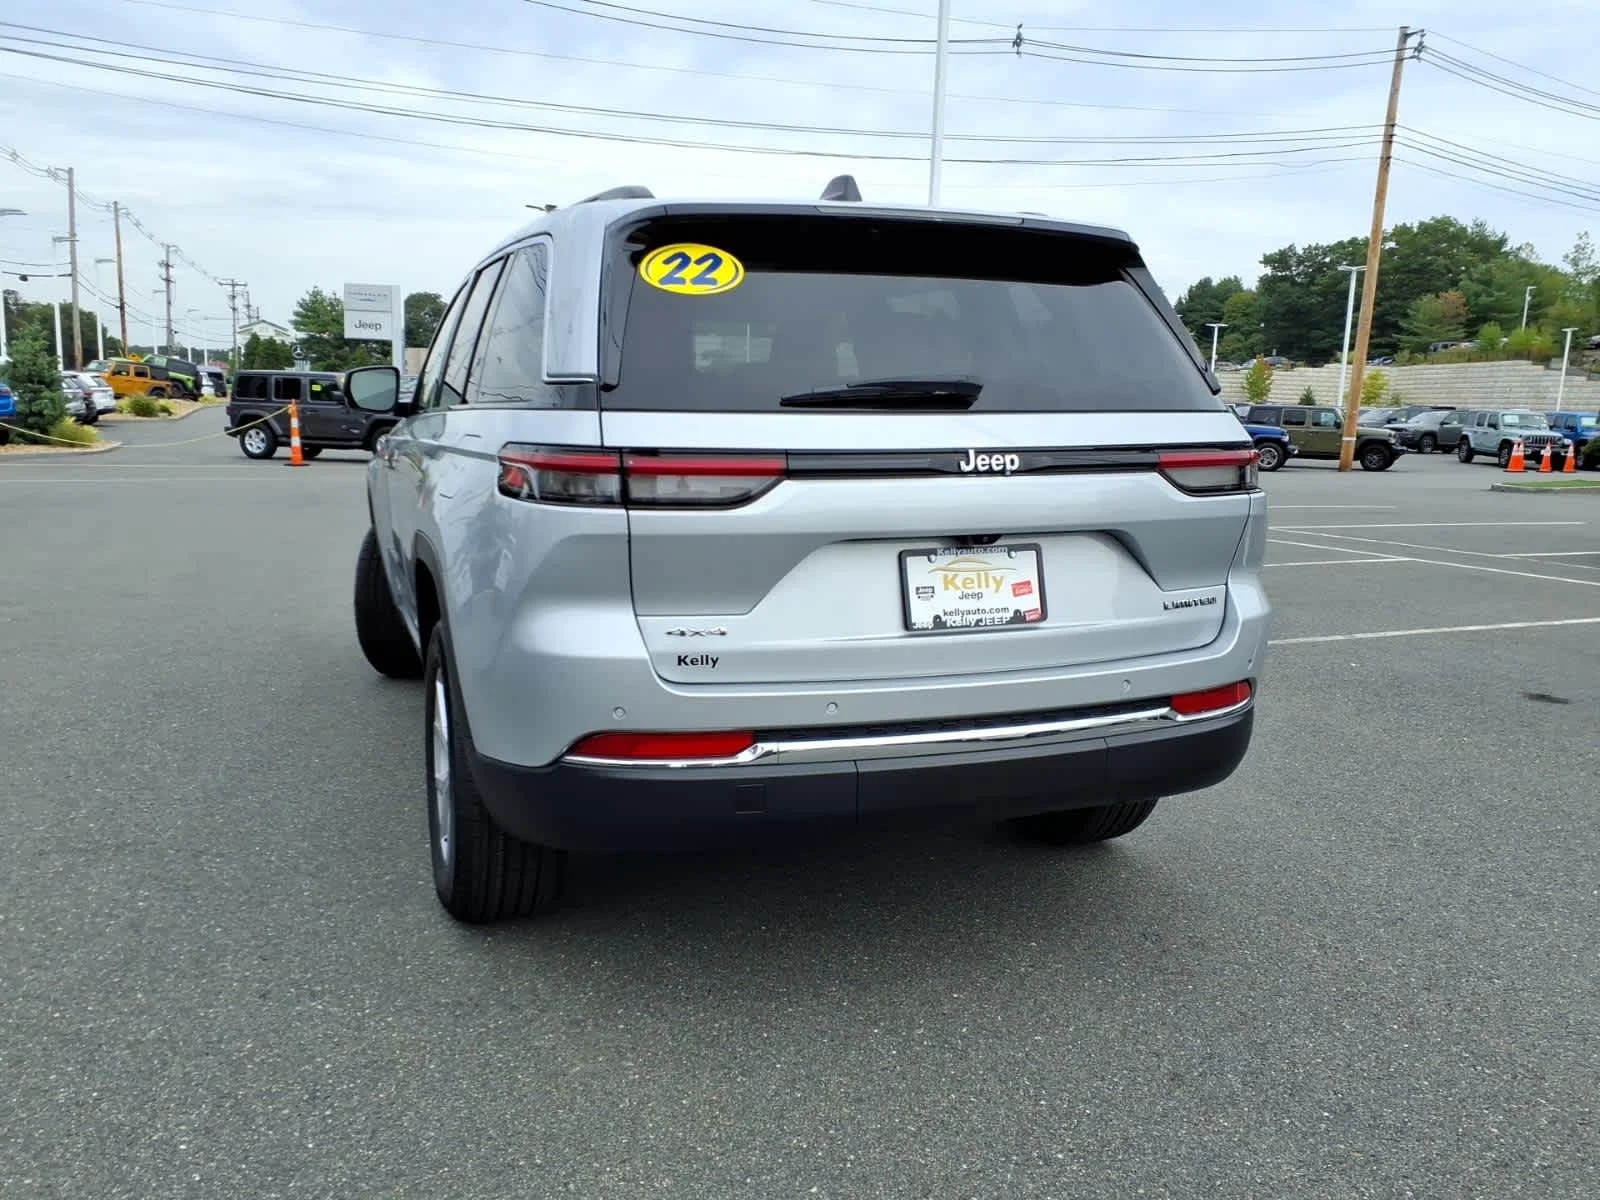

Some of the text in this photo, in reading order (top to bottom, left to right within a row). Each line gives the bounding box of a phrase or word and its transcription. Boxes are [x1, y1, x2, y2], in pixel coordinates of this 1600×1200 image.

[658, 251, 723, 286] 22
[354, 320, 382, 332] Jeep
[960, 448, 1020, 476] Jeep
[943, 573, 1005, 593] Kelly
[958, 591, 983, 601] Jeep
[943, 607, 1010, 618] kellyauto.com
[979, 616, 1010, 626] JEEP
[677, 654, 720, 669] Kelly
